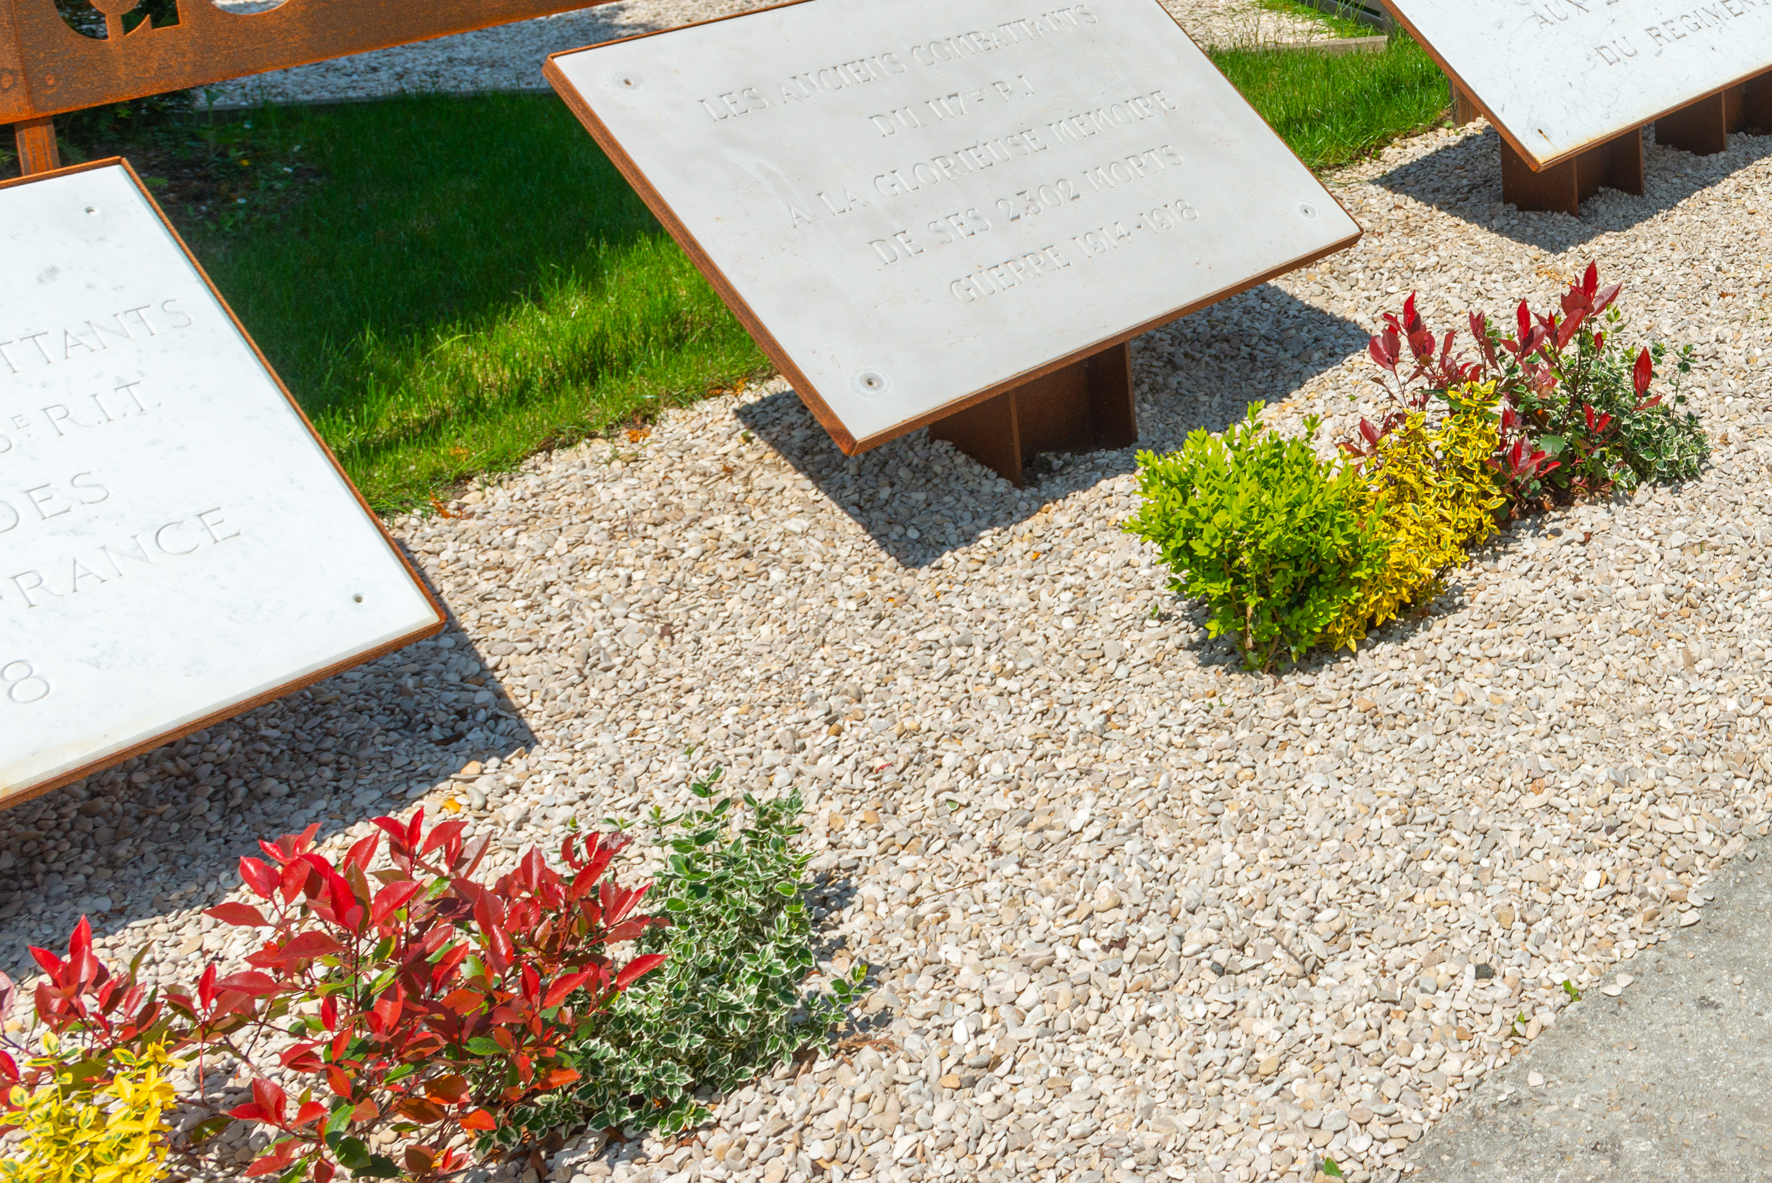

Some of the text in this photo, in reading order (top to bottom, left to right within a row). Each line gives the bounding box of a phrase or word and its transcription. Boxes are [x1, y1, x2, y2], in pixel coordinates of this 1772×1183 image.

[700, 4, 1099, 121] LES ANCIENS COMBATTANTS
[1594, 37, 1639, 65] DU
[870, 107, 923, 136] DU
[781, 201, 813, 228] A
[818, 184, 866, 216] LA
[871, 129, 1048, 199] GLORIEUSE
[870, 231, 923, 264] DE
[928, 207, 994, 245] SES
[1085, 144, 1184, 191] MORTS
[947, 245, 1070, 305] GUERRE
[0, 506, 241, 608] RANCE
